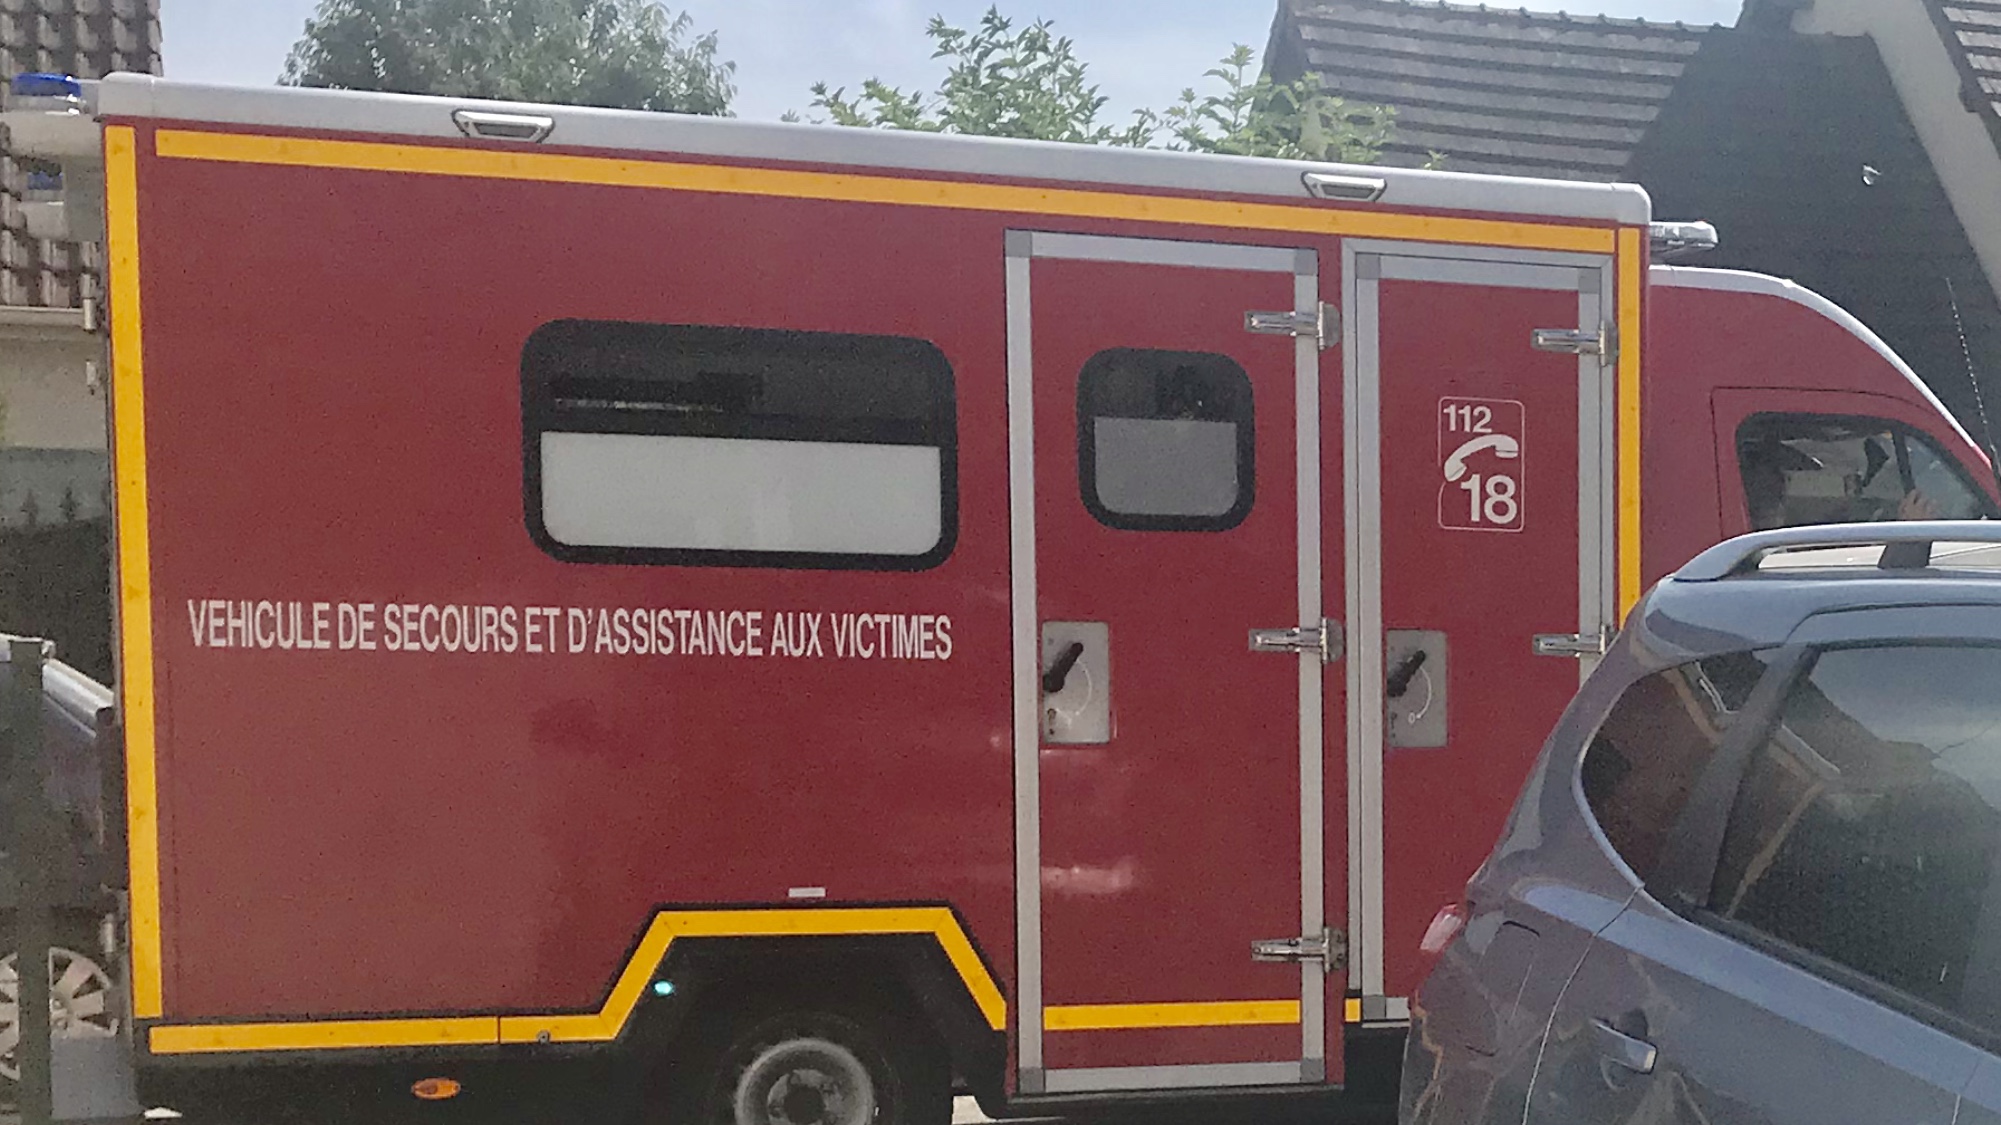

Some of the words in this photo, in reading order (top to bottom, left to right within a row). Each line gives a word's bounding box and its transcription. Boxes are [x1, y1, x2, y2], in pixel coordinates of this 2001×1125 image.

[1443, 404, 1493, 433] 112
[1460, 473, 1518, 525] 18
[187, 599, 332, 650] VEHICULE
[338, 602, 377, 651] DE
[383, 603, 519, 654] SECOURS
[524, 606, 561, 654] ET
[567, 607, 763, 658] D'ASSISTANCE
[770, 612, 824, 659] AUX
[830, 613, 953, 661] VICTIMES
